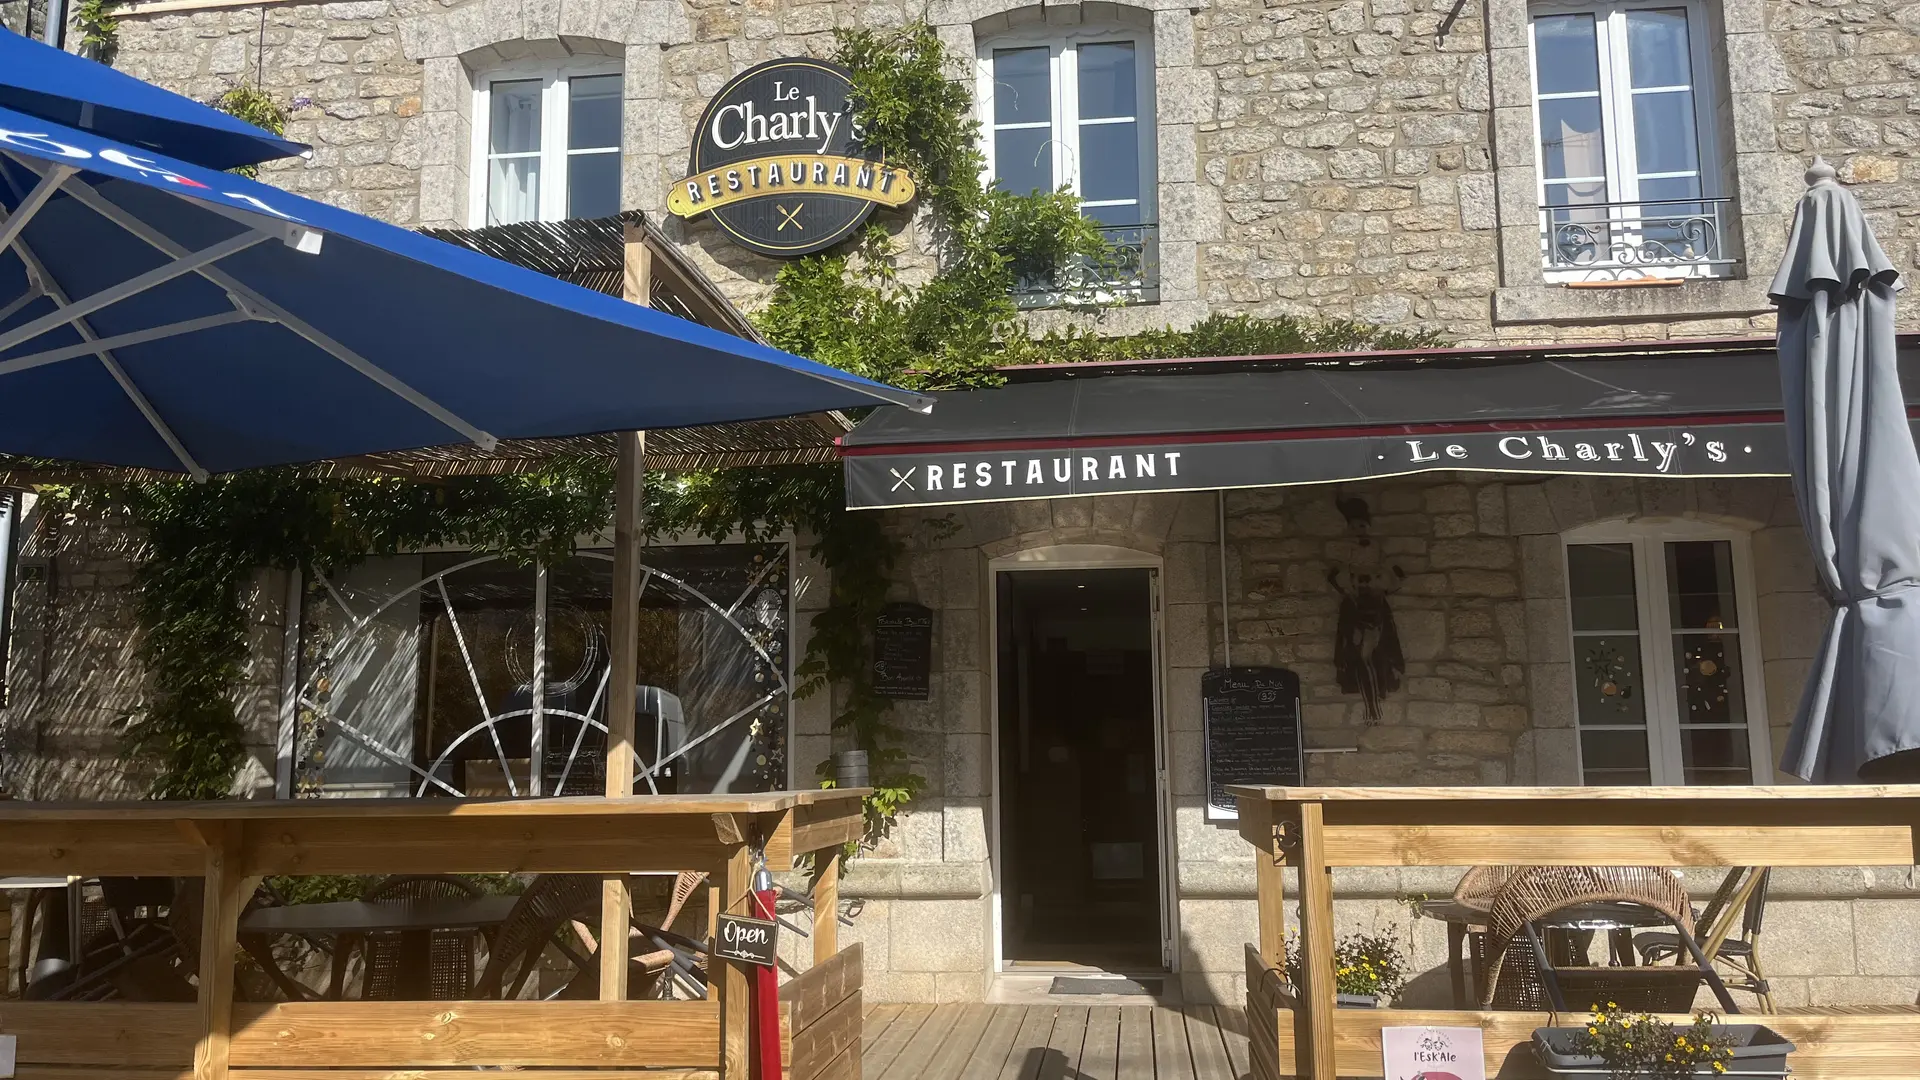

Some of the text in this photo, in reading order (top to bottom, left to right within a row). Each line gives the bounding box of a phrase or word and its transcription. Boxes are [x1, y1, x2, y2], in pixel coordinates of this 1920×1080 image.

[774, 81, 800, 102] Le
[687, 161, 894, 203] RESTAURANT
[1405, 432, 1727, 473] Le Charly's
[926, 452, 1181, 492] RESTAURANT
[29, 567, 38, 579] 2
[1223, 678, 1250, 690] Menu
[723, 920, 769, 950] Open
